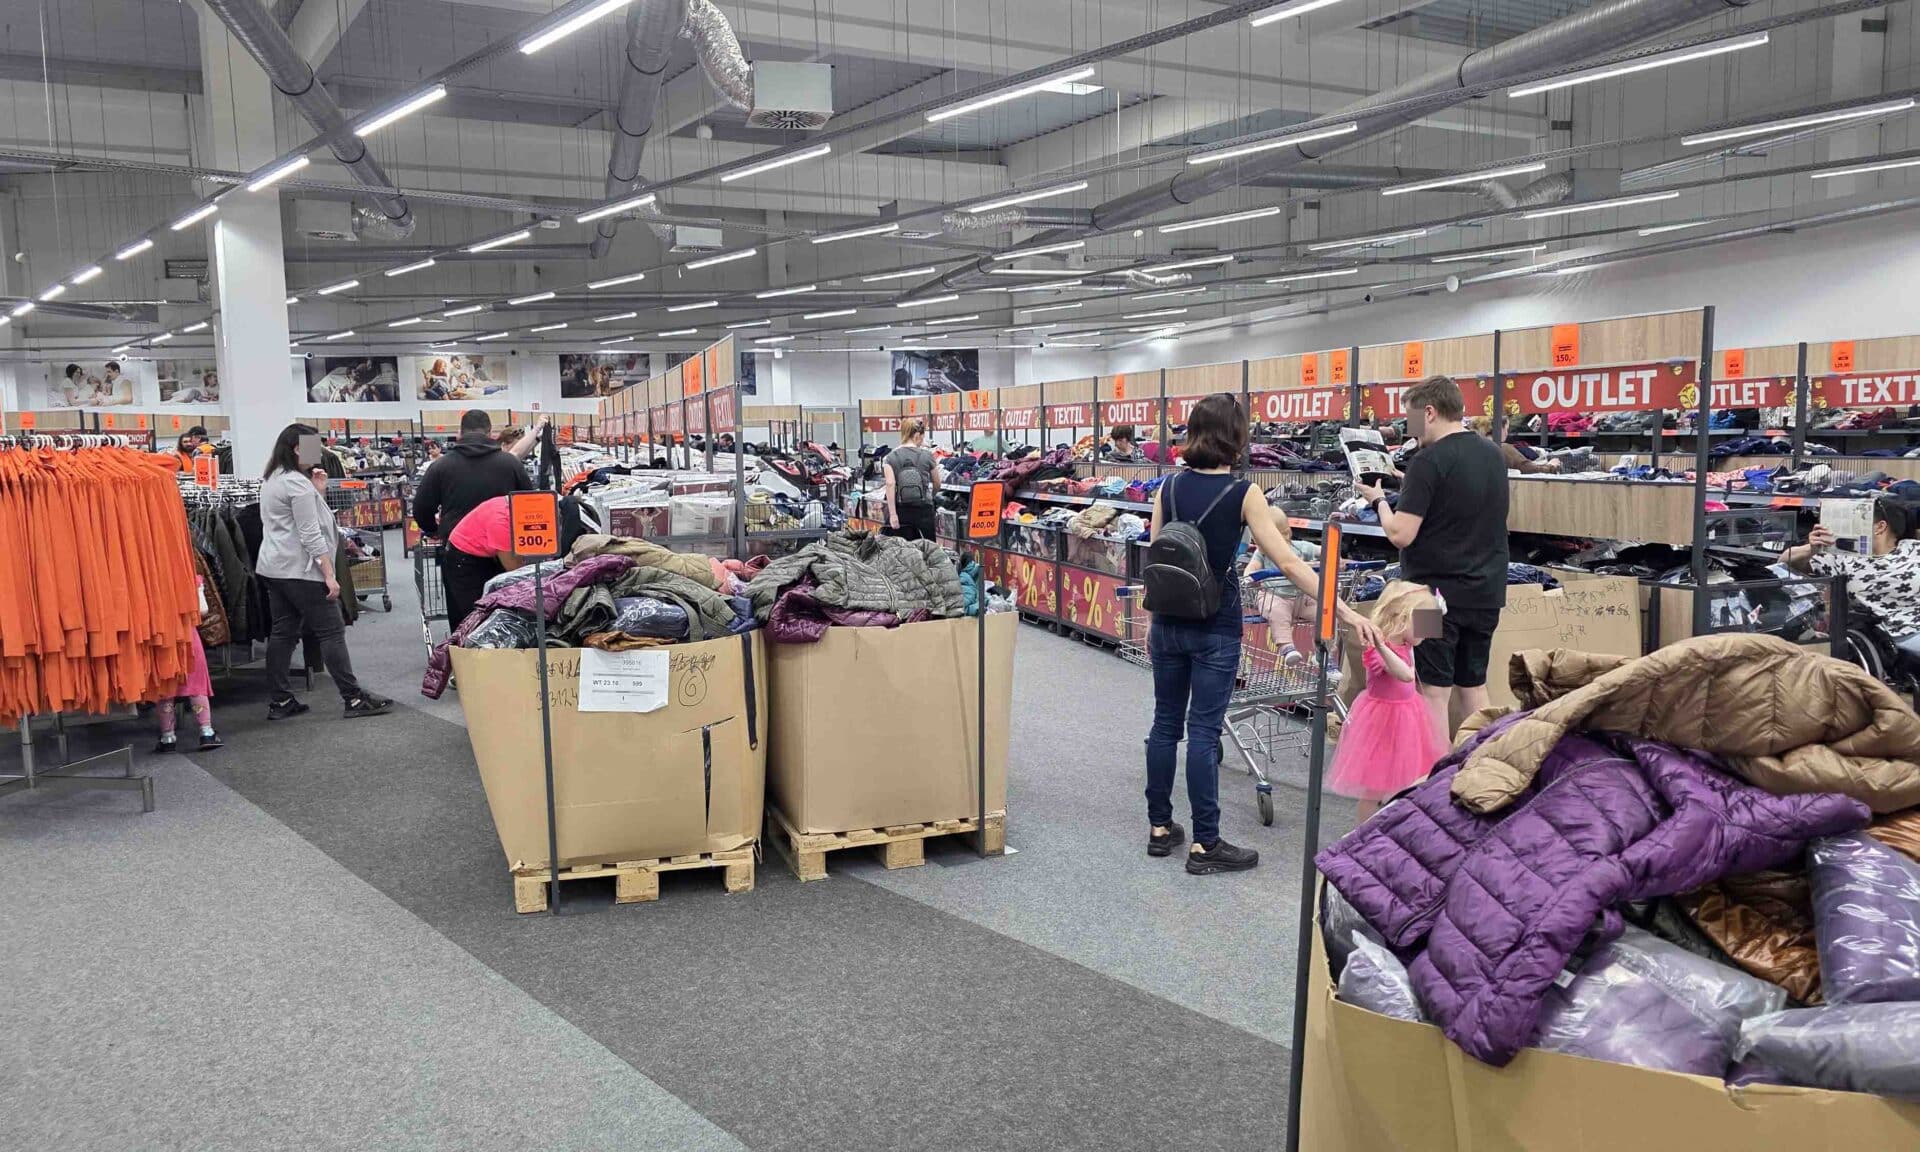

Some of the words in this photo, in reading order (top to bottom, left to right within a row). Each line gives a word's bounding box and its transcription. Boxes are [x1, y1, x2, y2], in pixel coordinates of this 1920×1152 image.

[1556, 354, 1575, 363] 150,-
[1531, 369, 1657, 409] OUTLET
[1108, 402, 1149, 423] OUTLET
[1266, 391, 1333, 419] OUTLET
[936, 415, 956, 430] OUTLET
[969, 412, 990, 428] TEXTIL
[1005, 409, 1032, 427] OUTLET
[1054, 406, 1085, 425] TEXTIL
[971, 521, 995, 529] 400,00
[518, 535, 553, 548] 300,-
